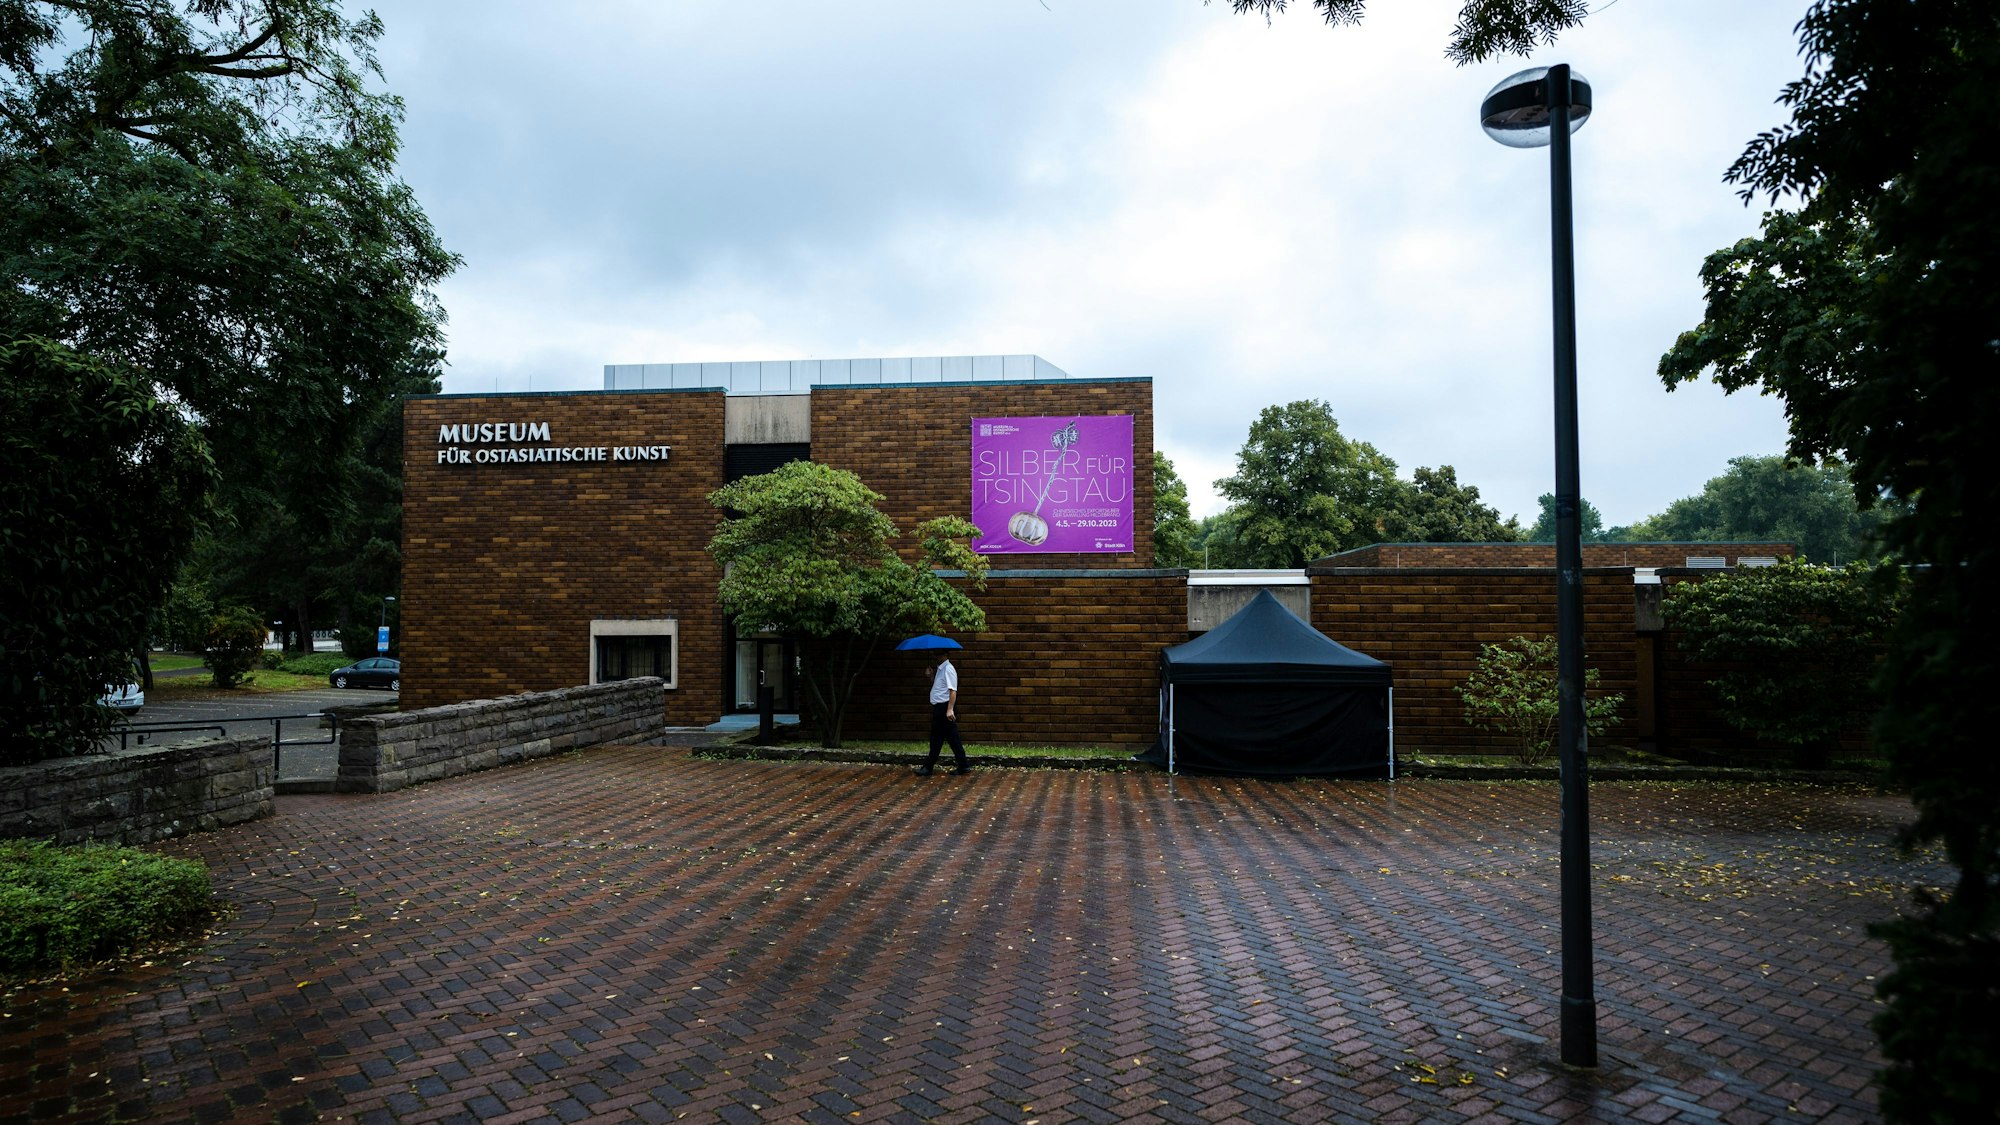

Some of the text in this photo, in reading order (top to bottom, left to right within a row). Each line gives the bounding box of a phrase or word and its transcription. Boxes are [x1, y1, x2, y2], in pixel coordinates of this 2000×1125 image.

[438, 422, 551, 443] MUSEUM
[437, 445, 671, 464] FÜR OSTASIATISCHE KUNST
[979, 449, 1126, 476] SILBER FÜR
[978, 477, 1126, 504] TSINGTAU
